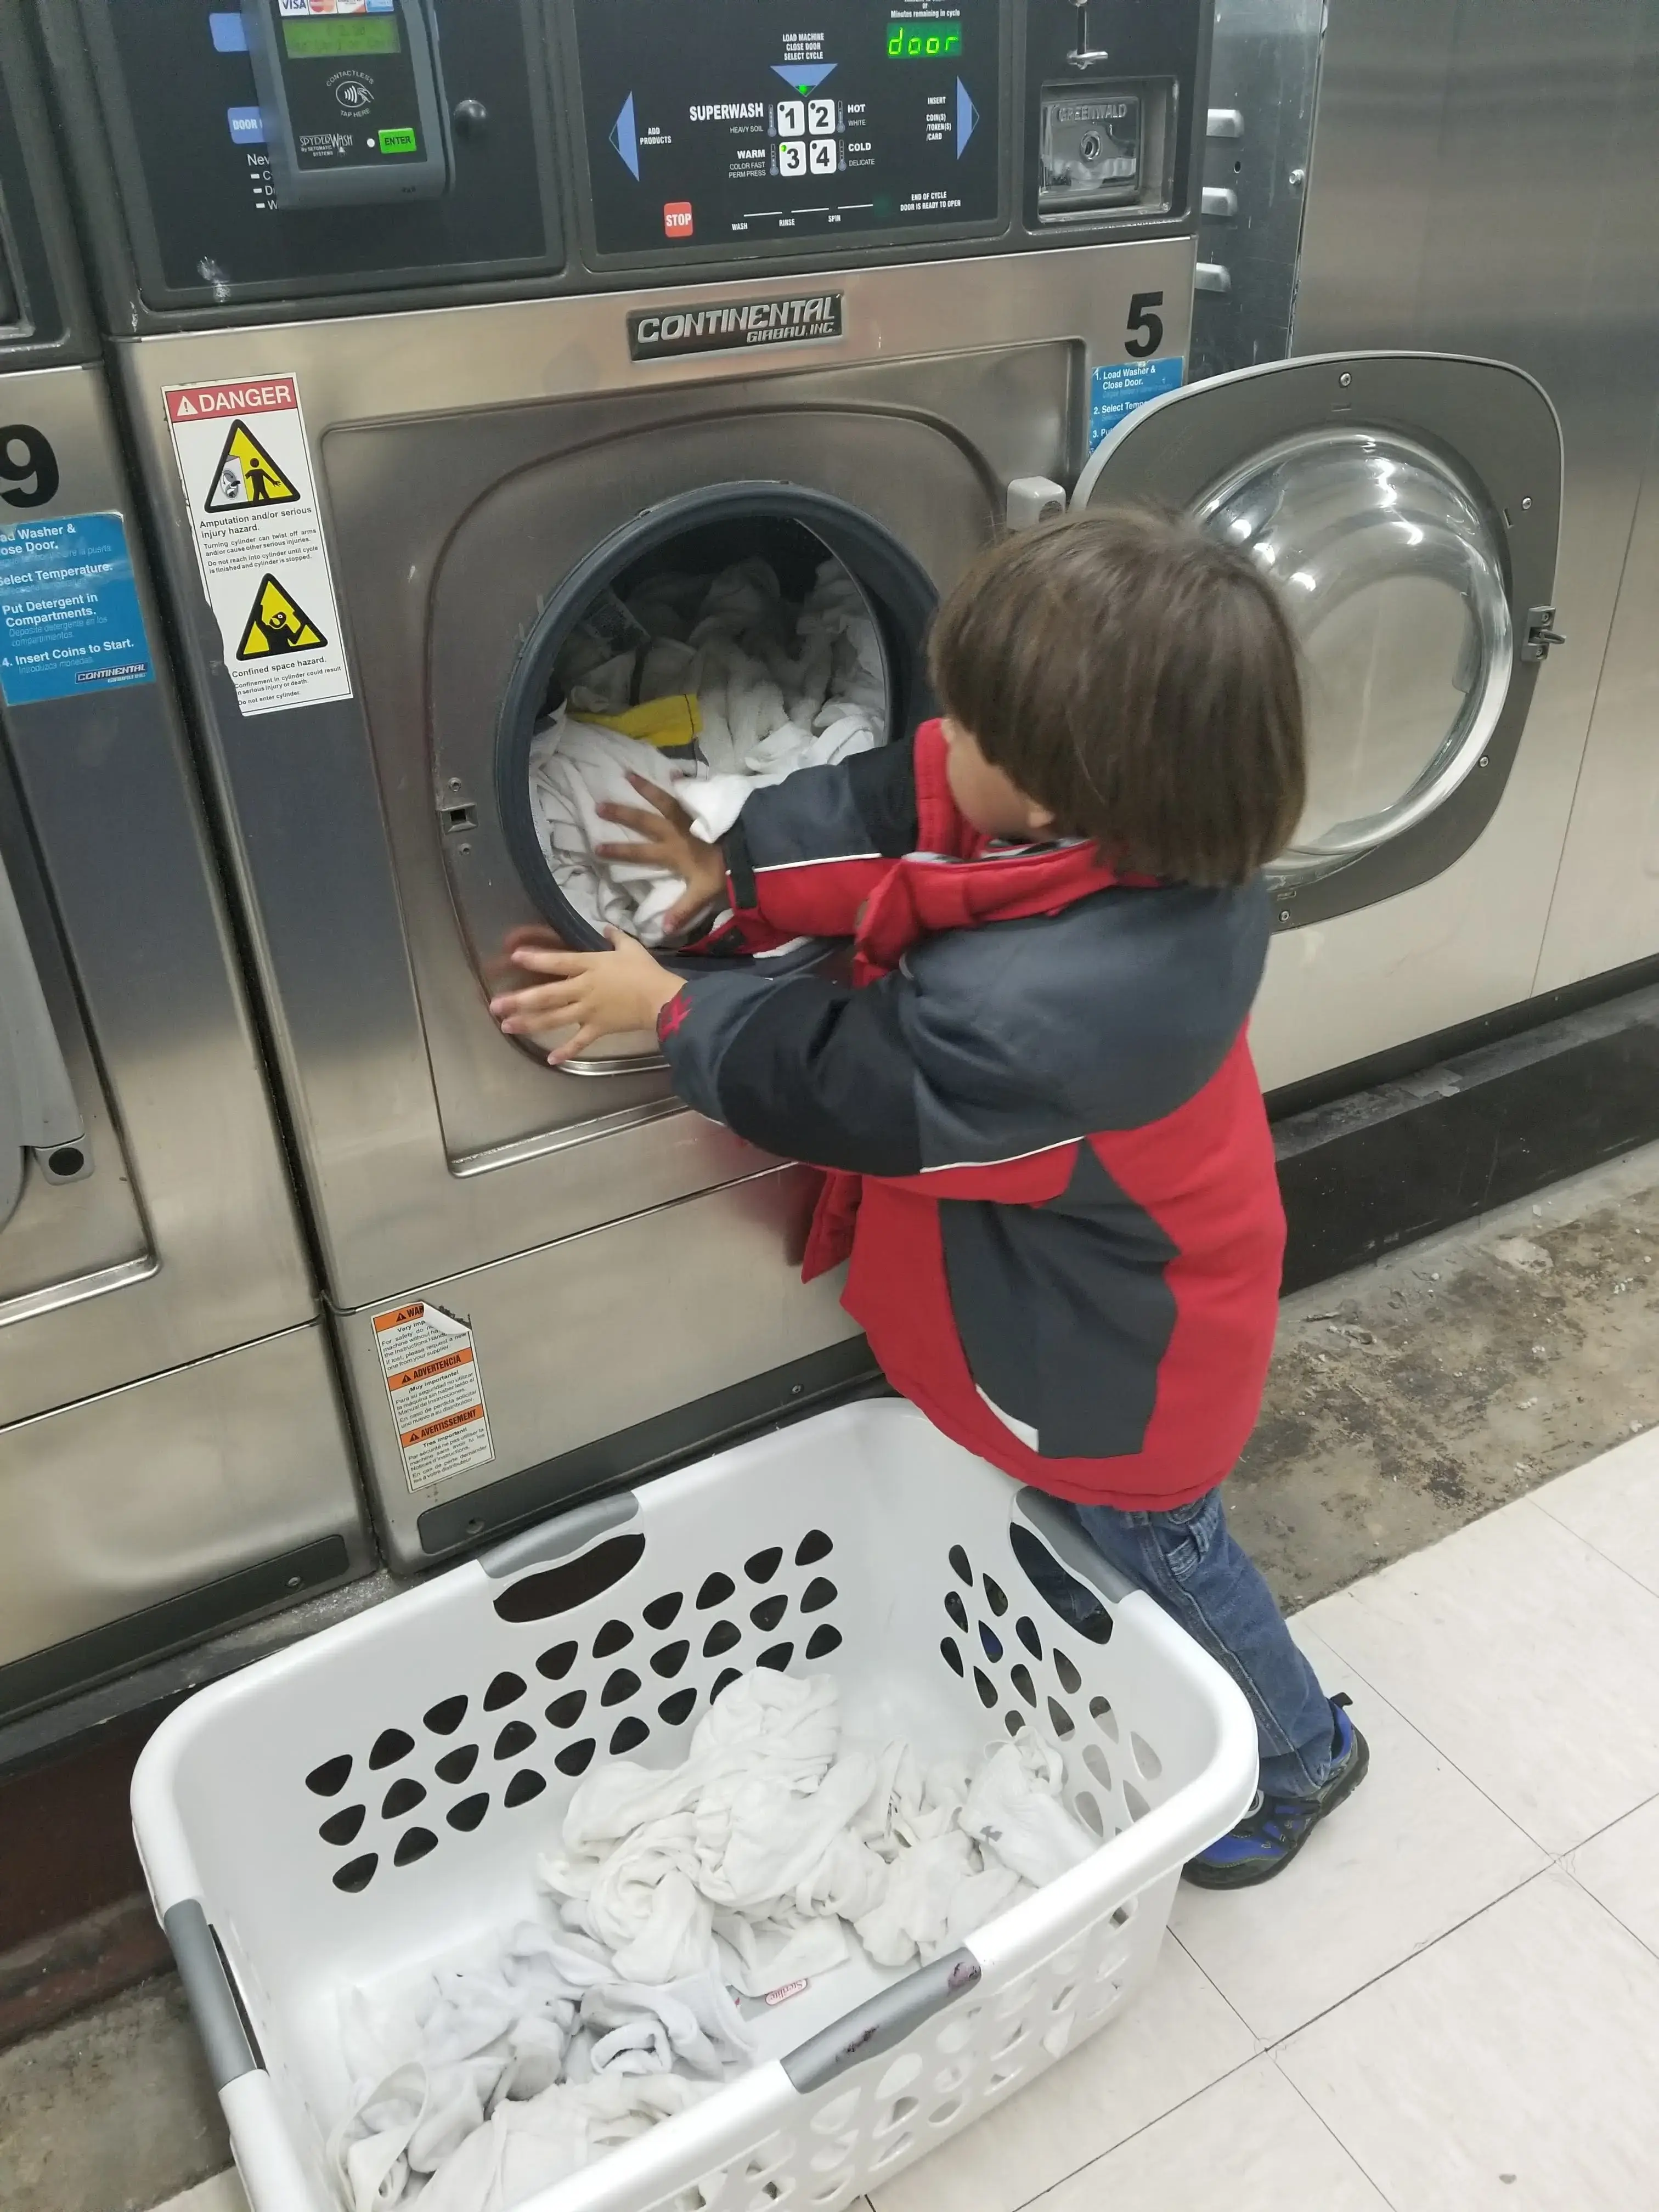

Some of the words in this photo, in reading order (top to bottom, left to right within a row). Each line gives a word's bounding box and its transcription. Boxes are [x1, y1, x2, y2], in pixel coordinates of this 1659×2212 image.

[283, 0, 307, 9] VISA
[913, 9, 939, 18] remaining
[946, 9, 960, 18] cycle
[783, 33, 797, 42] LOAD
[798, 33, 824, 41] MACHINE
[888, 27, 958, 55] door
[805, 42, 821, 50] DOOR
[784, 52, 805, 60] SELECT
[326, 70, 374, 87] CONTACTLESS
[928, 97, 946, 105] INSERT
[353, 108, 371, 117] HERE
[690, 102, 764, 121] SUPERWASH
[848, 104, 866, 113] HOT
[785, 108, 795, 129] 1
[815, 106, 829, 127] 2
[926, 114, 946, 122] COIN(S)
[233, 119, 257, 130] DOOR
[926, 123, 951, 132] /TOKEN(S)
[648, 127, 660, 136] ADD
[926, 133, 942, 141] /CARD
[385, 136, 411, 145] ENTER
[640, 136, 672, 145] PRODUCTS
[848, 143, 871, 151] COLD
[737, 149, 765, 159] WARM
[787, 148, 799, 169] 3
[816, 146, 830, 167] 4
[931, 191, 947, 200] CYCLE
[922, 201, 939, 210] READY
[666, 213, 691, 227] STOP
[779, 218, 795, 227] RINSE
[731, 223, 748, 231] WASH
[637, 297, 835, 343] CONTINENTAL
[1125, 291, 1163, 358] 5
[1103, 371, 1121, 380] Load
[1122, 367, 1149, 377] Washer
[1150, 365, 1156, 374] &
[1103, 379, 1122, 390] Close
[1124, 377, 1143, 387] Door.
[199, 385, 292, 413] DANGER
[1094, 407, 1100, 415] 2.
[1102, 404, 1124, 413] Select
[0, 424, 59, 507] 9
[200, 516, 249, 528] Amputation
[251, 511, 278, 521] and/or
[280, 507, 311, 516] serious
[18, 527, 63, 539] Washer
[67, 523, 76, 533] &
[201, 529, 225, 539] injury
[228, 523, 259, 534] hazard.
[25, 540, 58, 552] Door.
[230, 537, 255, 546] cylinder
[262, 550, 286, 559] cylinder
[215, 564, 240, 572] finished
[254, 559, 278, 567] cylinder
[285, 554, 312, 562] stopped.
[35, 563, 112, 580] Temperature.
[2, 603, 23, 614] Put
[25, 595, 83, 611] Detergent
[86, 593, 98, 602] in
[5, 607, 95, 627] Compartments.
[15, 651, 49, 664] Insert
[52, 647, 86, 658] Coins
[88, 644, 100, 653] to
[103, 639, 133, 651] Start.
[77, 664, 145, 681] CONTINENTAL
[232, 665, 269, 678] Confined
[271, 662, 295, 672] space
[297, 656, 326, 666] hazard.
[234, 678, 272, 689] Confinement
[281, 673, 304, 681] cylinder
[414, 1355, 461, 1378] ADVERTENCIA
[421, 1409, 475, 1437] AVERTISSEMENT
